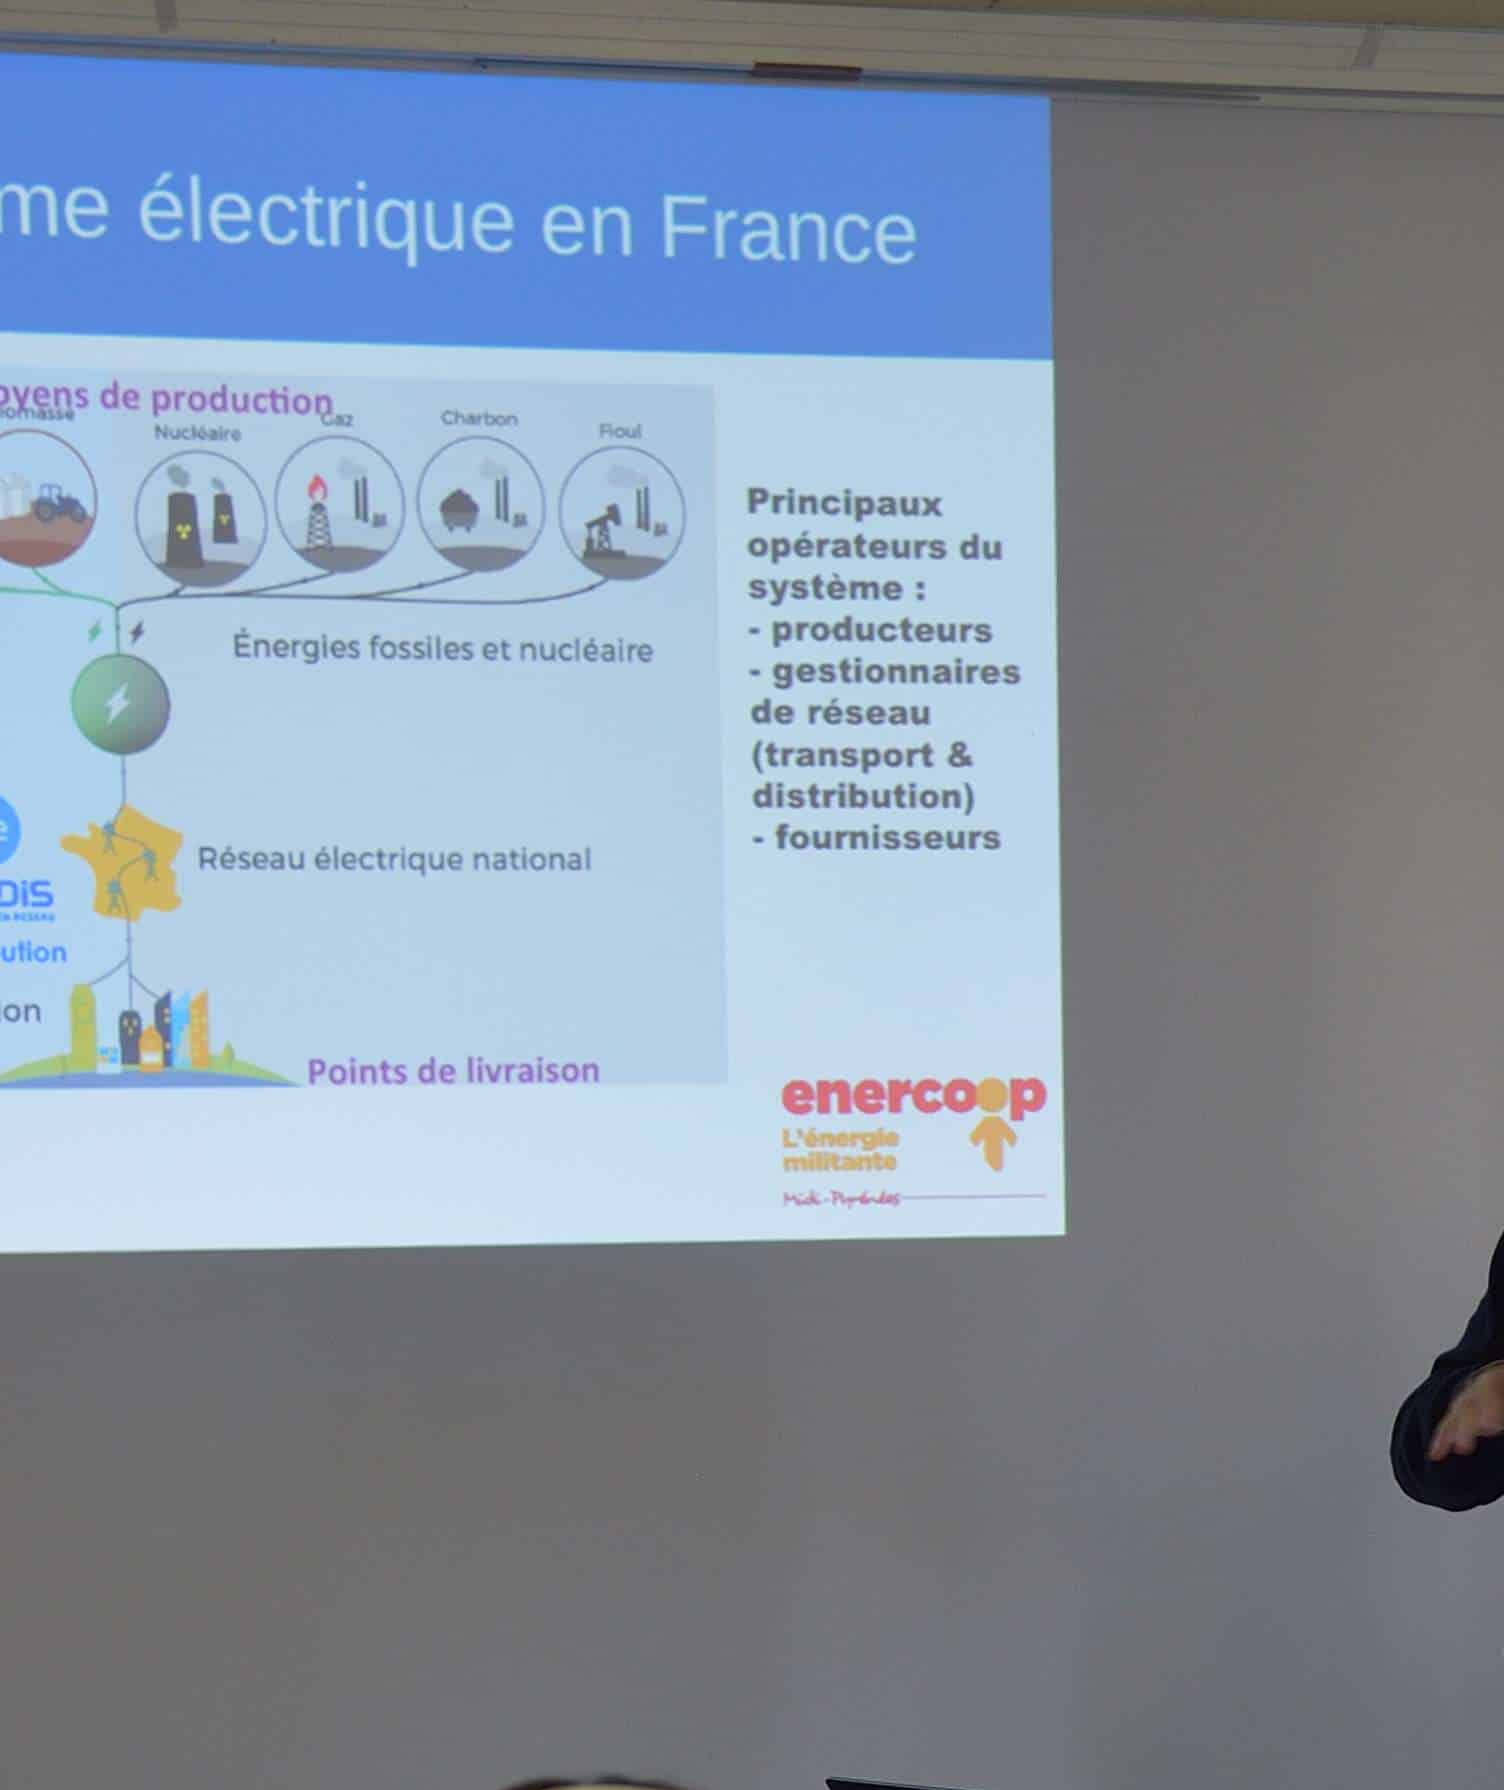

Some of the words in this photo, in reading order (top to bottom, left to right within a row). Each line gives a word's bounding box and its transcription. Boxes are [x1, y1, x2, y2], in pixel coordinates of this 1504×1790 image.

[141, 171, 514, 267] électrique
[544, 204, 633, 257] en
[664, 193, 917, 266] France
[100, 381, 140, 410] de
[152, 385, 333, 417] production
[155, 423, 241, 442] Nucléaire
[442, 408, 518, 426] Charbon
[600, 422, 643, 440] Fioul
[748, 489, 943, 522] Principaux
[748, 531, 947, 563] opérateurs
[961, 533, 1003, 559] du
[748, 573, 903, 605] système
[916, 578, 926, 600] :
[772, 615, 993, 647] producteurs
[233, 629, 359, 667] Énergies
[370, 635, 475, 662] fossiles
[483, 639, 510, 662] et
[520, 635, 653, 663] nucléaire
[773, 658, 1021, 692] gestionnaires
[752, 700, 794, 727] de
[808, 698, 931, 727] réseau
[753, 740, 933, 772] (transport
[948, 743, 972, 769] &
[753, 783, 975, 813] distribution)
[775, 825, 1001, 851] fournisseurs
[199, 846, 304, 872] Réseau
[314, 846, 463, 877] électrique
[473, 847, 591, 871] national
[308, 1059, 407, 1085] Points
[417, 1059, 456, 1084] de
[467, 1057, 599, 1084] livraison
[782, 1077, 1047, 1121] enercoop
[782, 1128, 899, 1150] L'énergie
[783, 1151, 896, 1172] militante
